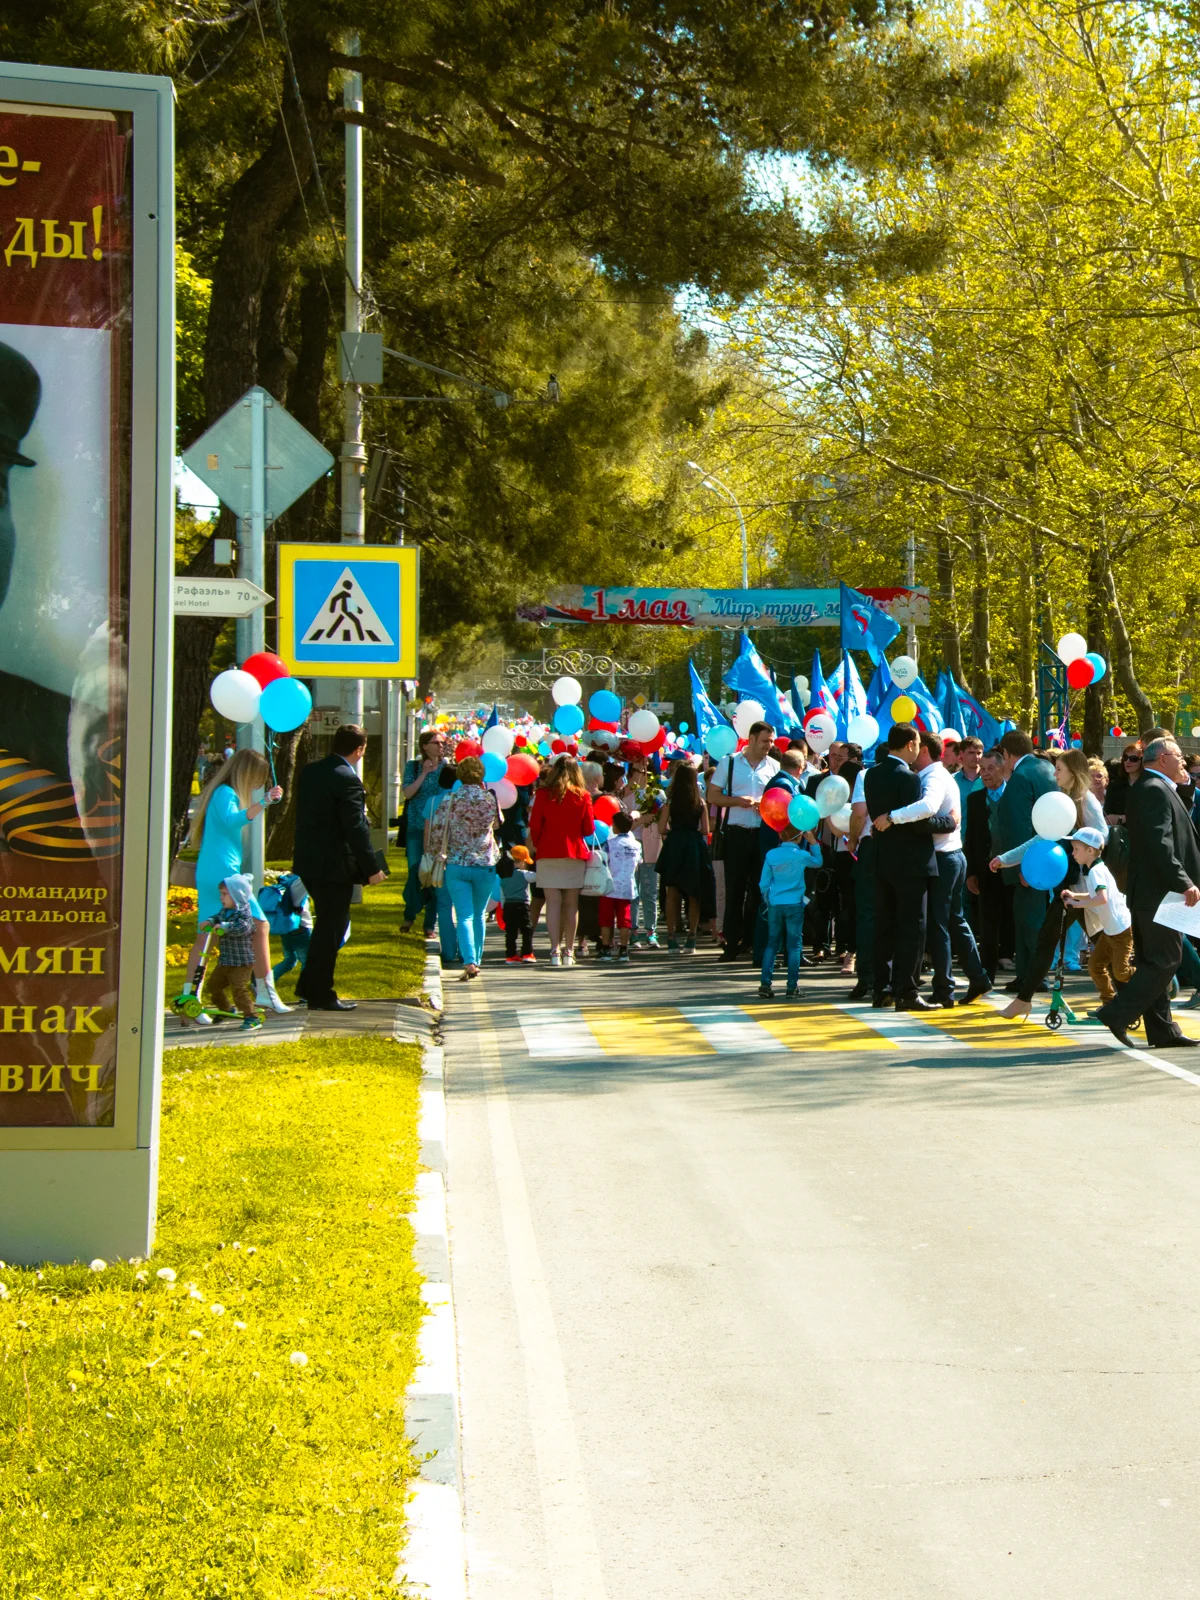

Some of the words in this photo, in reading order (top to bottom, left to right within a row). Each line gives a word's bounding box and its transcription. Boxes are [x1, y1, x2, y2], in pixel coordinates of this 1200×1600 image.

[174, 586, 231, 597] Рафаэль»
[236, 591, 251, 601] 70
[591, 589, 609, 620] 1
[618, 597, 694, 621] мая
[711, 597, 761, 623] Мир,
[323, 716, 340, 726] 16
[0, 885, 108, 906] омандир
